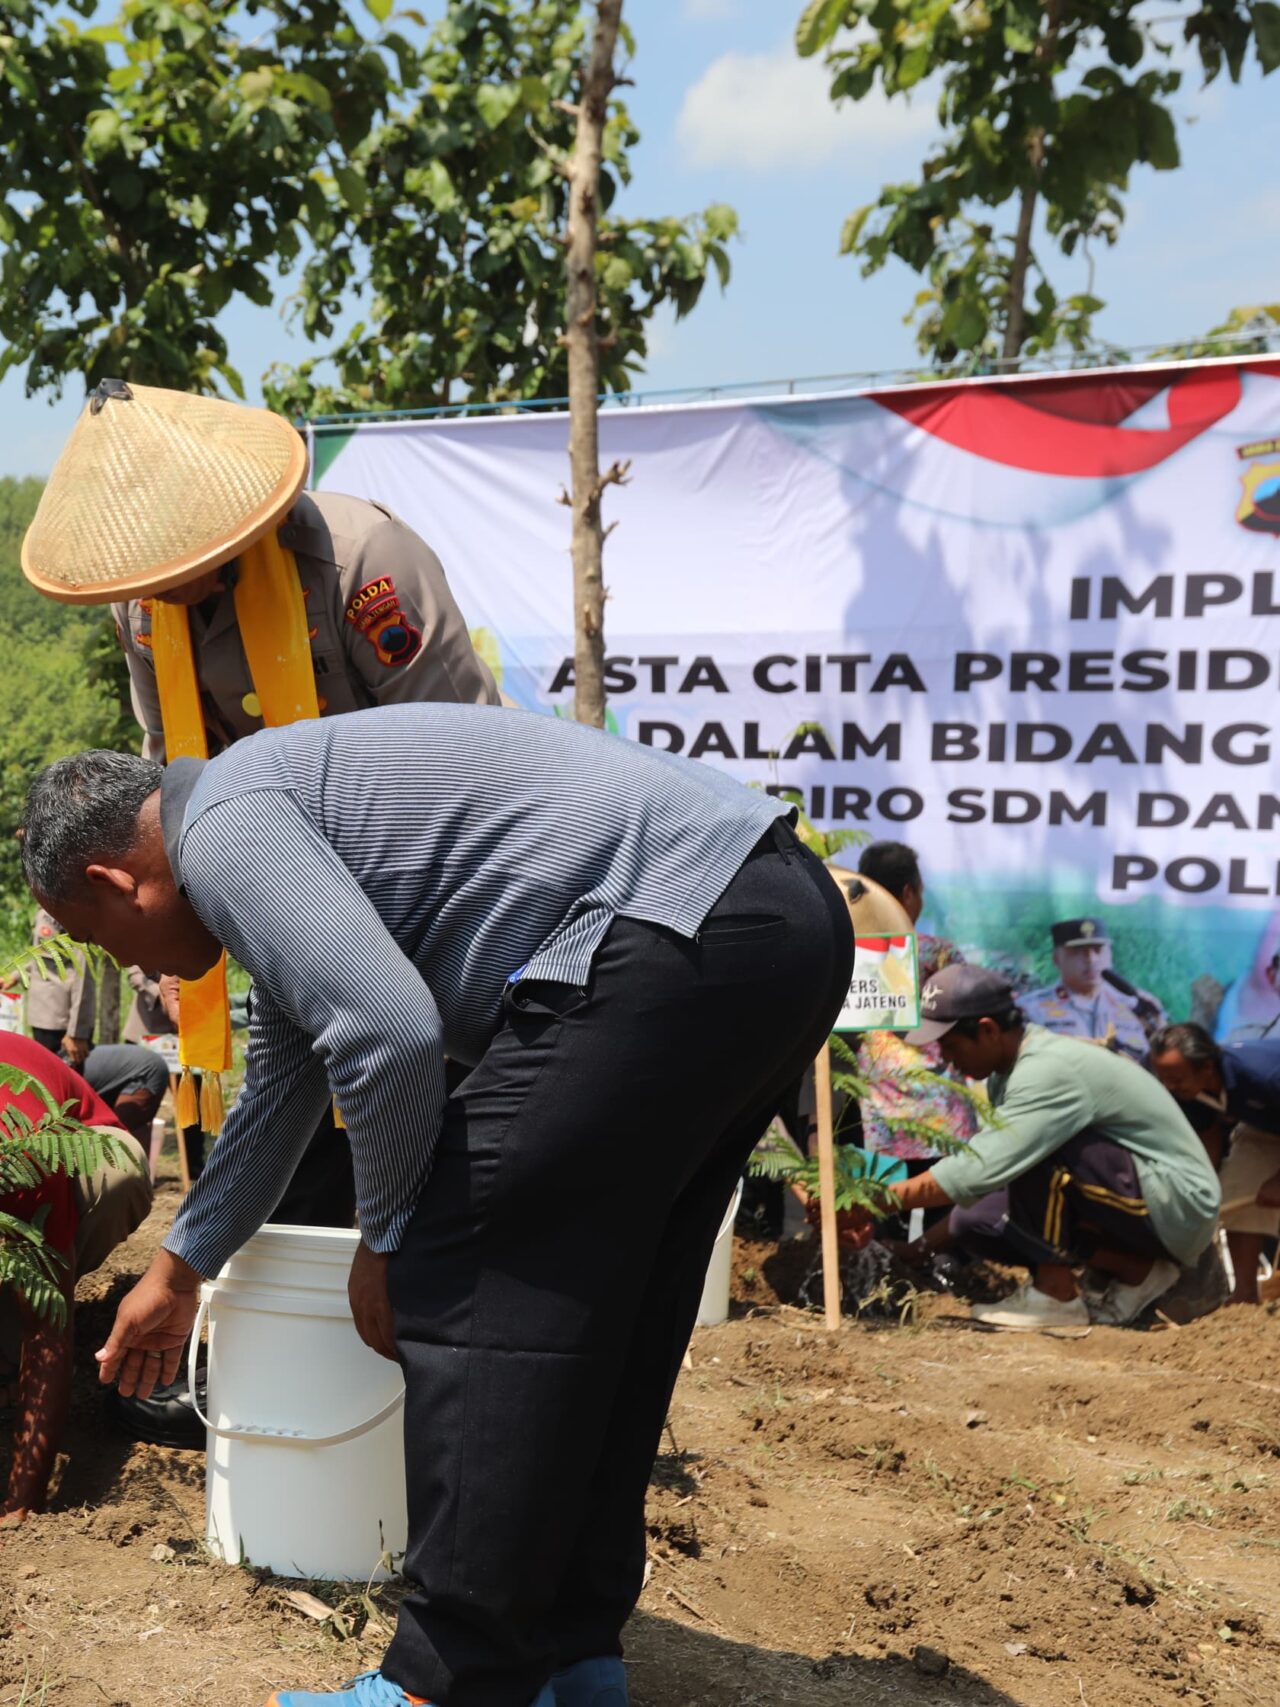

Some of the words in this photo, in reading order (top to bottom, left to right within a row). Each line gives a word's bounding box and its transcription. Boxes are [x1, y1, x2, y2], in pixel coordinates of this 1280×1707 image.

[346, 579, 390, 619] POLDA
[1069, 571, 1280, 620] IMPL
[548, 655, 730, 694] ASTA
[752, 653, 927, 694] CITA
[953, 649, 1280, 692] PRESID
[638, 720, 902, 761] DALAM
[930, 721, 1272, 766] BIDANG
[946, 788, 1108, 827] SDM
[1111, 855, 1280, 895] POL
[849, 979, 878, 994] ERS
[855, 995, 907, 1009] JATENG
